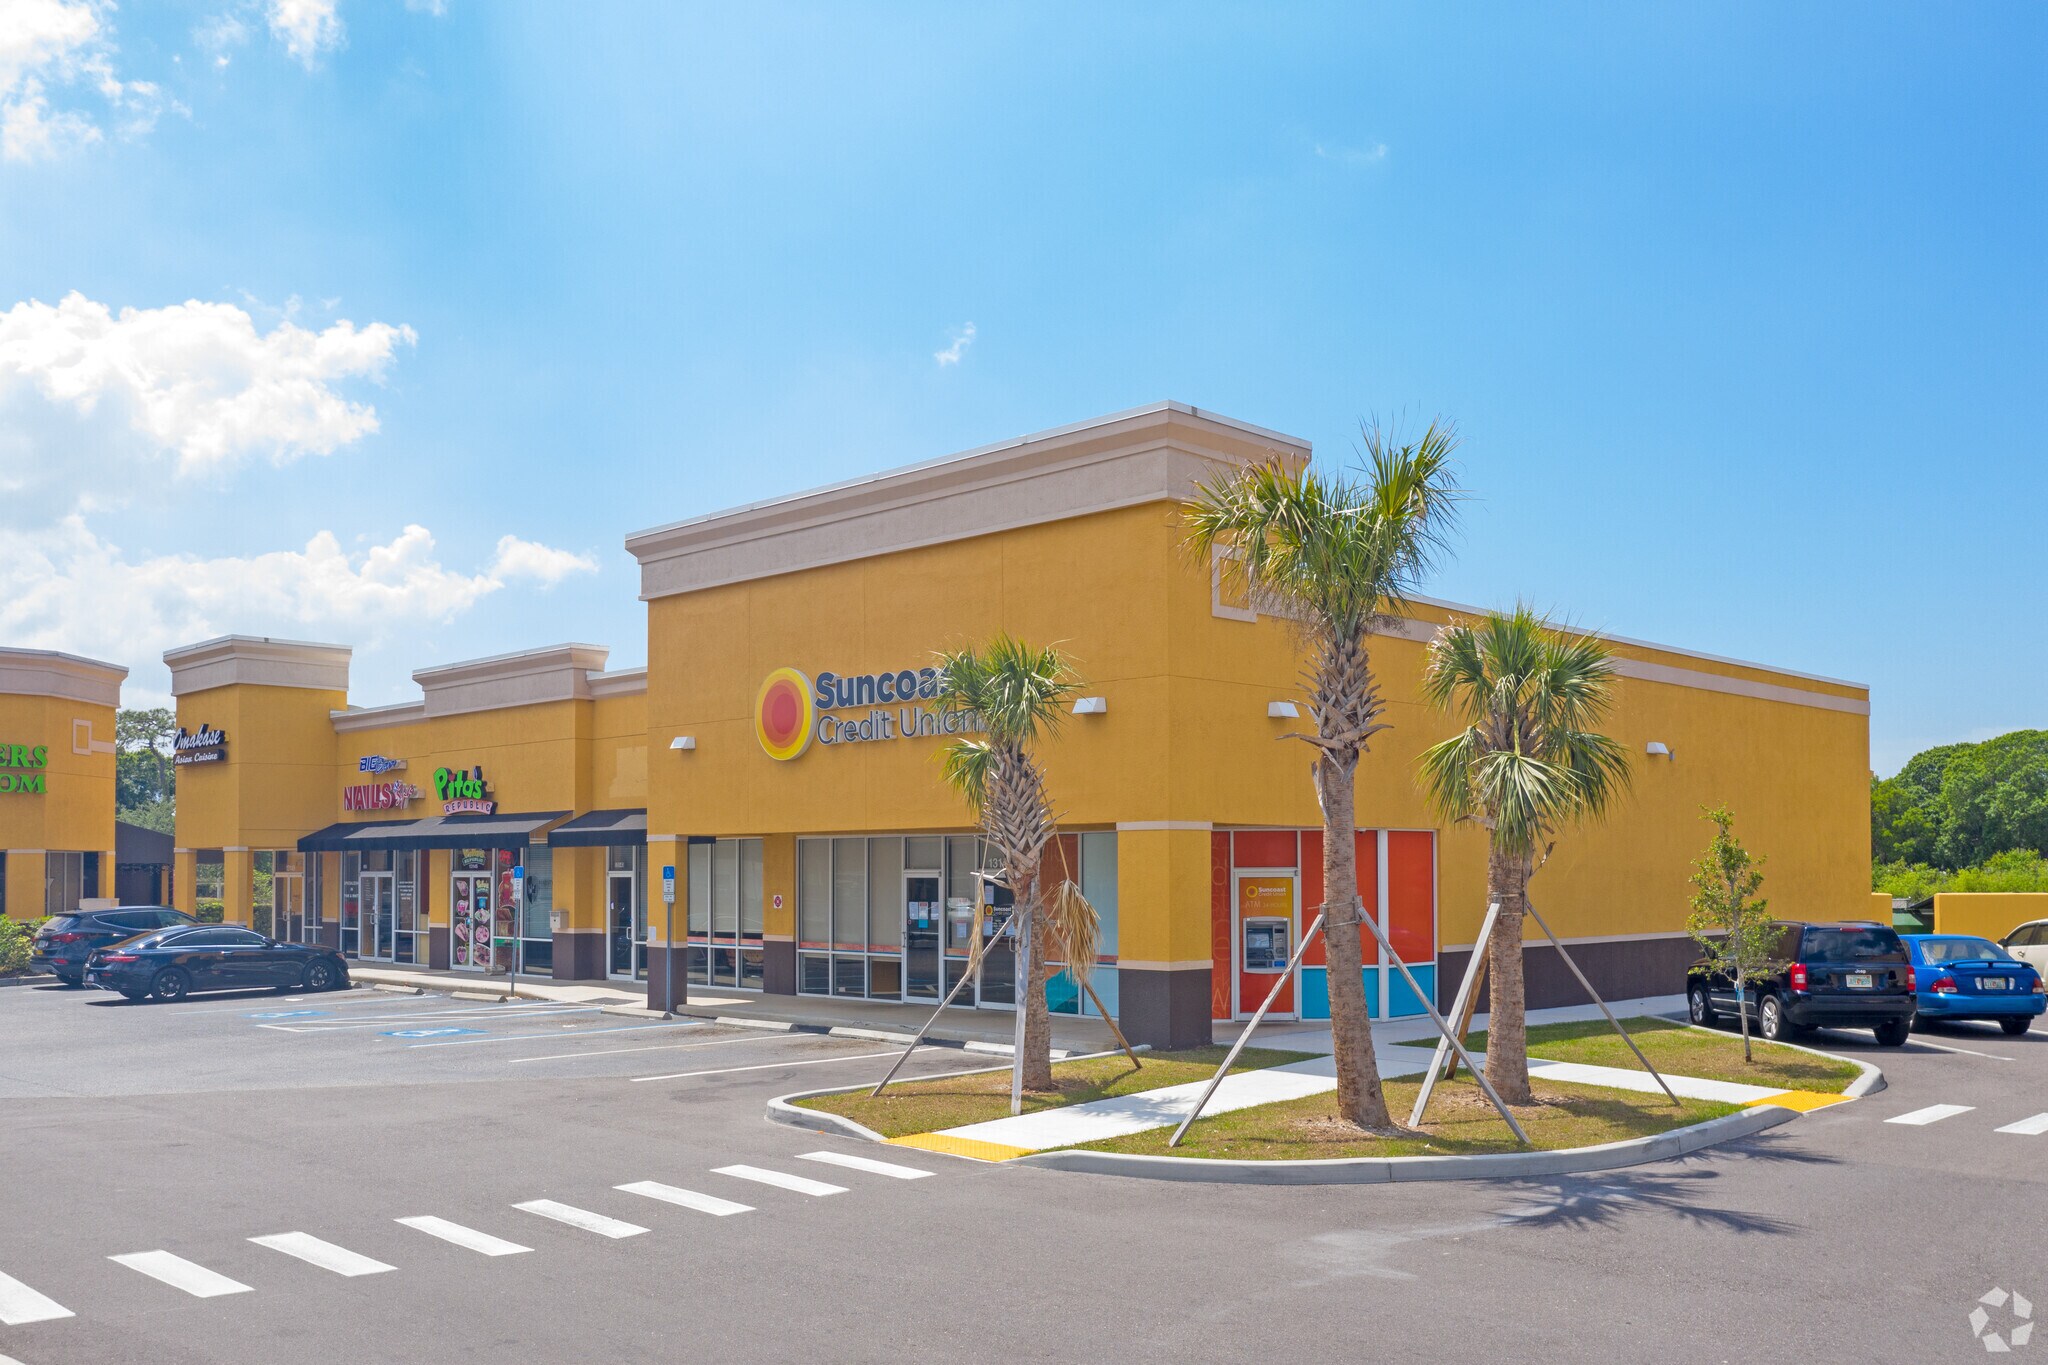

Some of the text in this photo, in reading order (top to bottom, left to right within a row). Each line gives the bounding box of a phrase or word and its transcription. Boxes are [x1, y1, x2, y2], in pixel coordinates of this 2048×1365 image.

[173, 724, 221, 750] Omakase
[817, 711, 891, 745] Credit
[174, 750, 218, 764] Asian Cuisine
[434, 766, 482, 800] Pita's
[344, 783, 391, 810] NAILS
[444, 801, 491, 814] REPUBLIC
